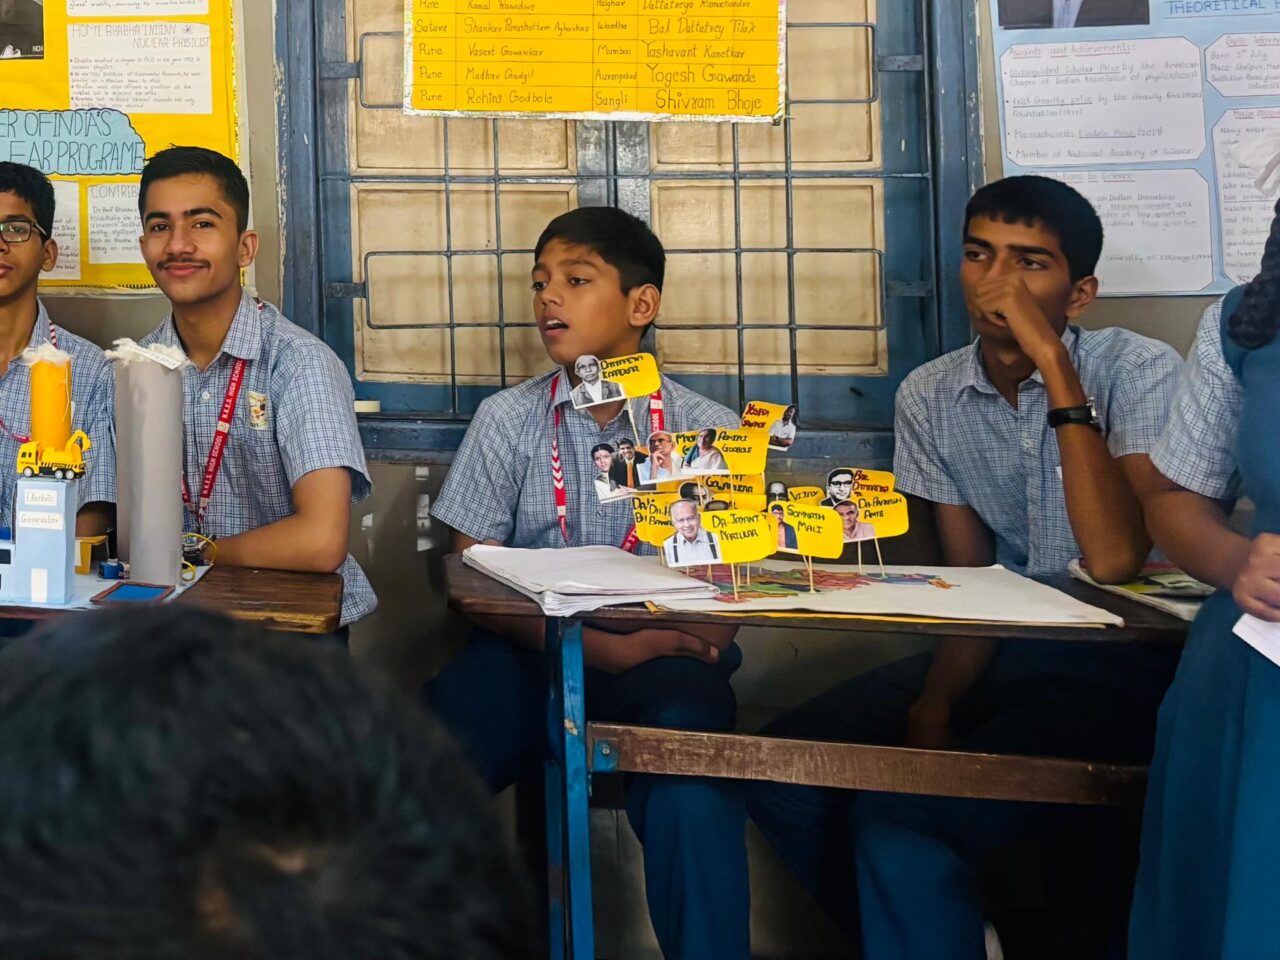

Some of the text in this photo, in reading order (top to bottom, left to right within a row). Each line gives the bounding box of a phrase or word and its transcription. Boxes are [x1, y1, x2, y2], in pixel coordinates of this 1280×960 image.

[646, 64, 694, 88] Yogesh
[595, 91, 628, 111] Sangli
[24, 112, 49, 137] OF
[798, 521, 822, 534] MALI
